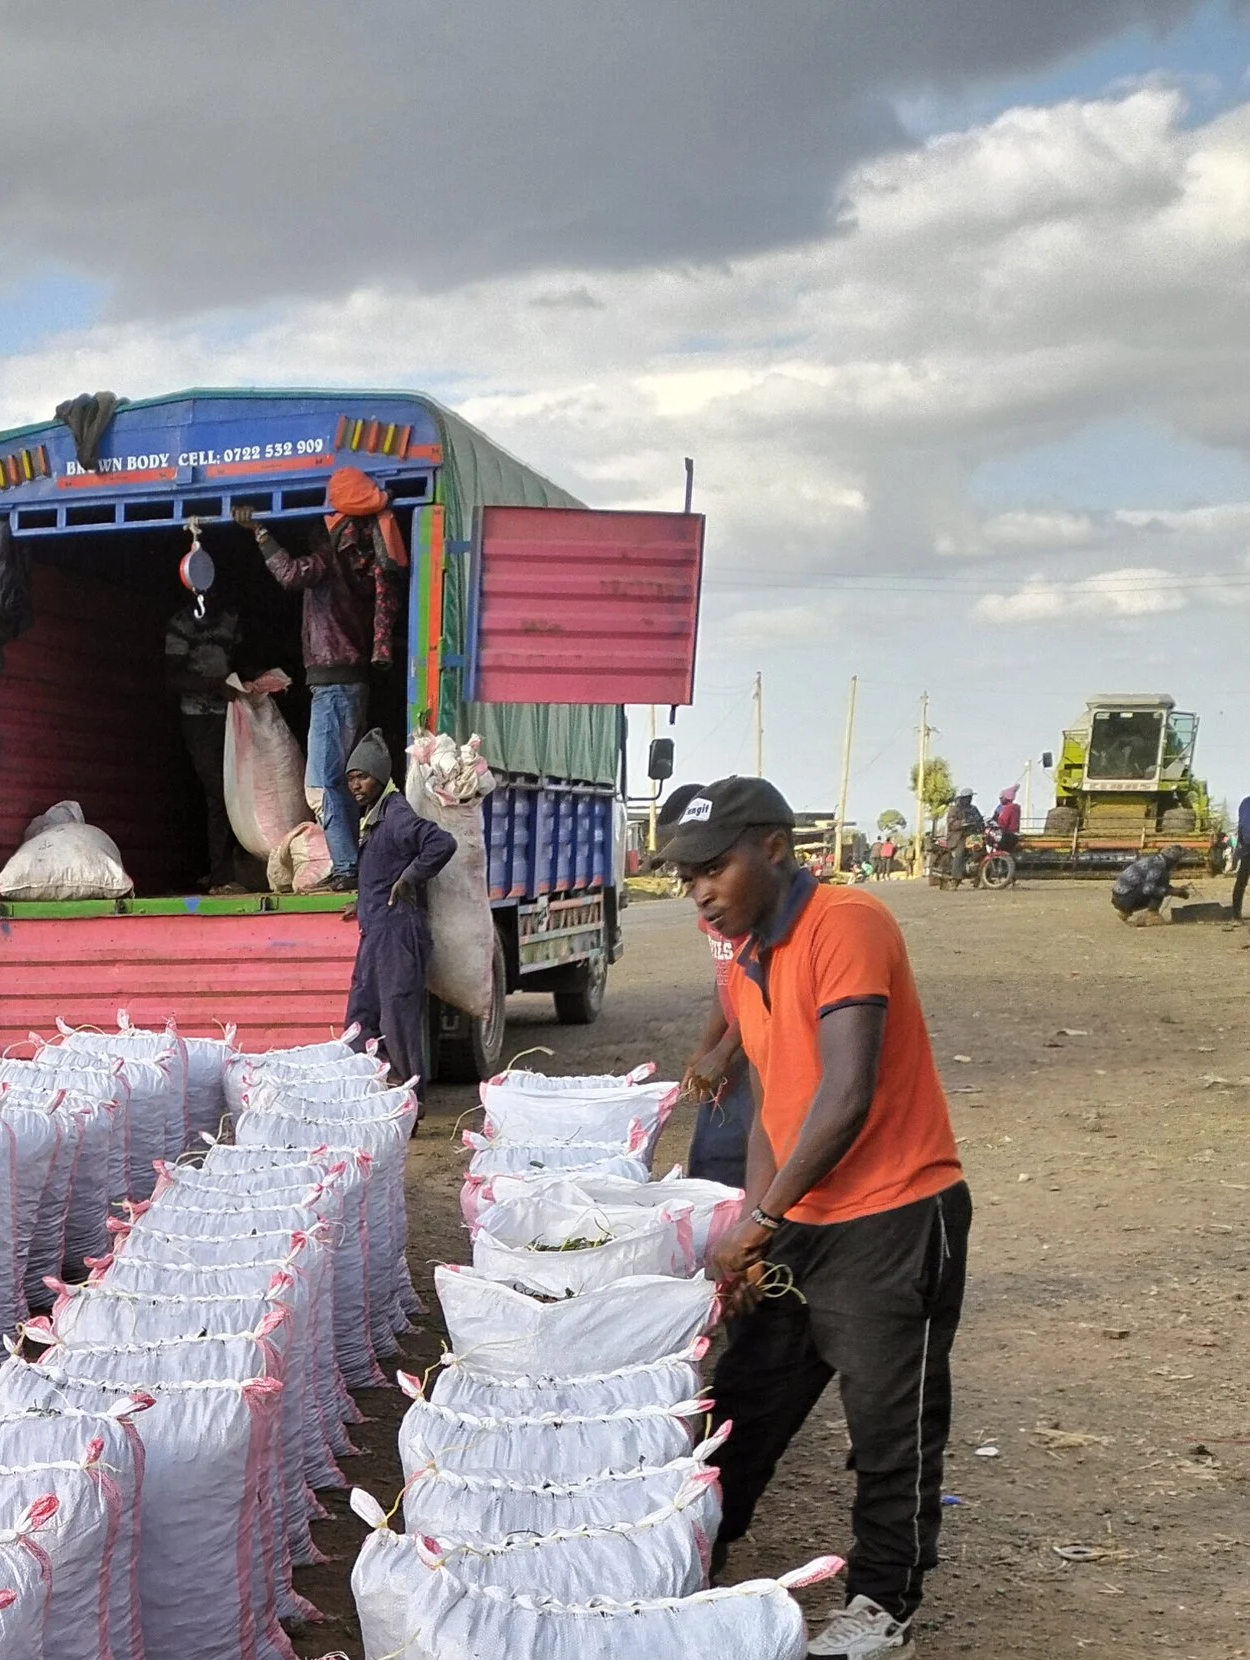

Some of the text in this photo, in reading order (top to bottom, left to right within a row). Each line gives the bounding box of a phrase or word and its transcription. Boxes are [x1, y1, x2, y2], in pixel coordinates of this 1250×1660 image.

[66, 438, 324, 476] BRWN BODY CELL: 0722 532 909
[686, 803, 710, 816] angit
